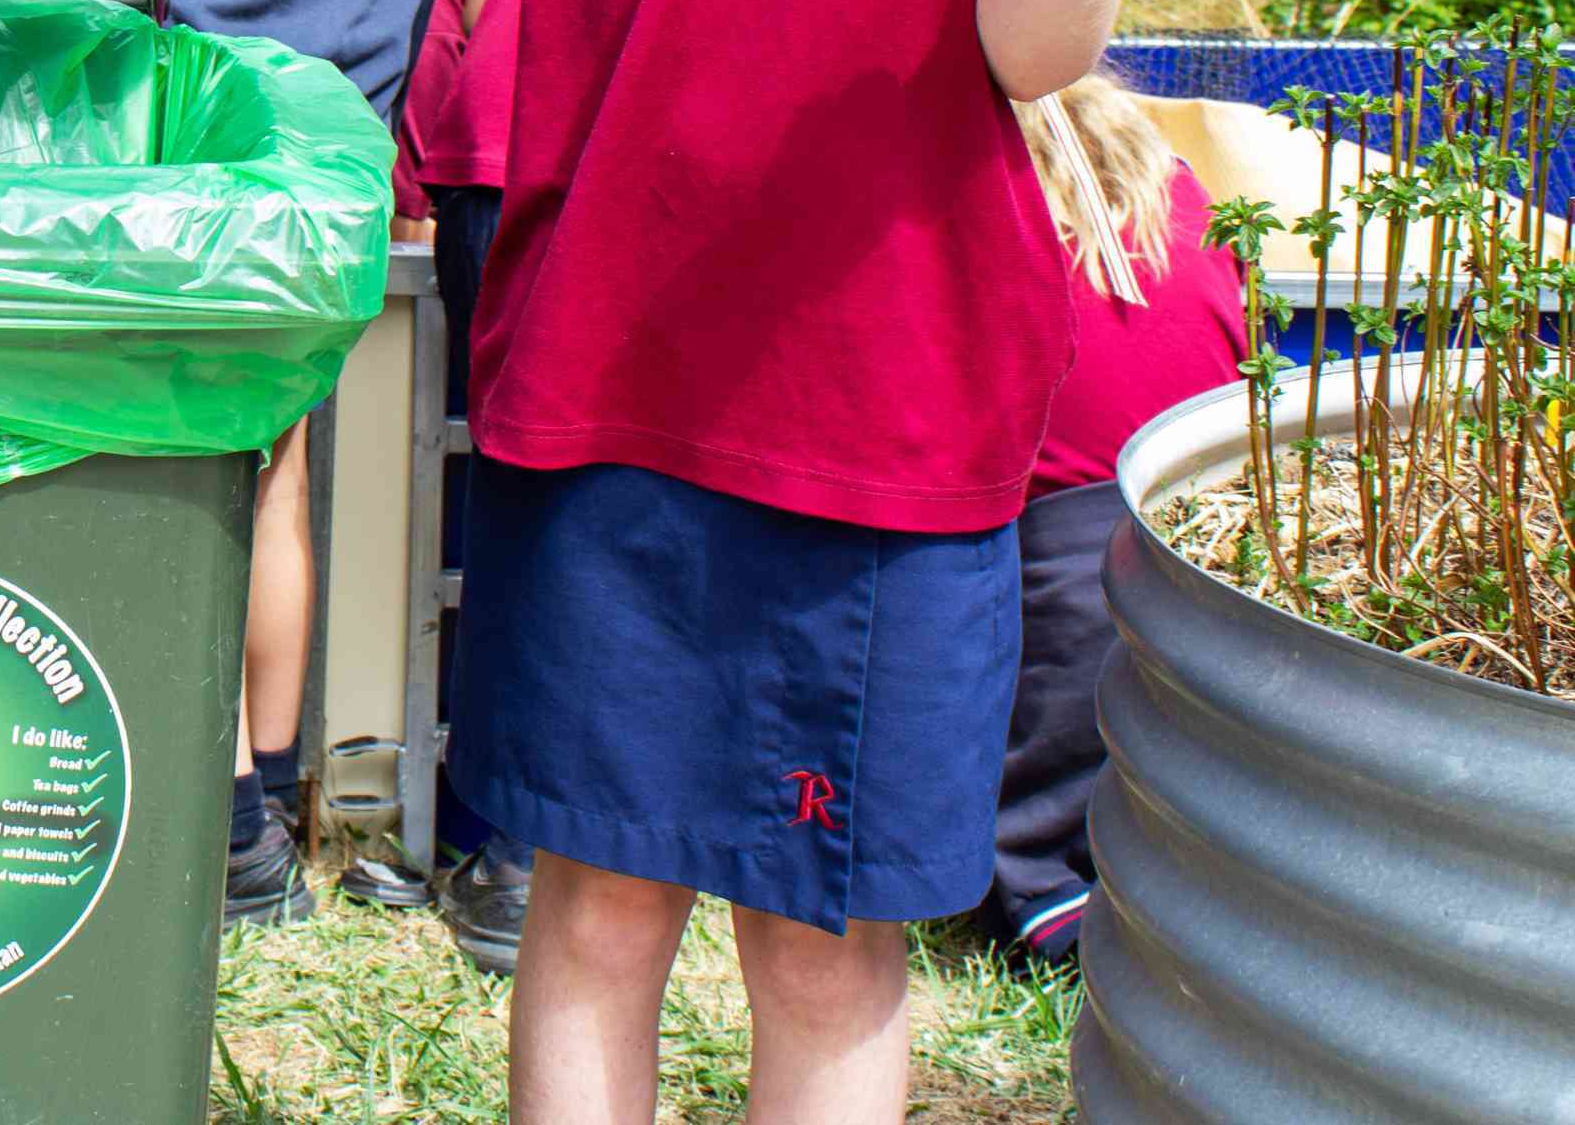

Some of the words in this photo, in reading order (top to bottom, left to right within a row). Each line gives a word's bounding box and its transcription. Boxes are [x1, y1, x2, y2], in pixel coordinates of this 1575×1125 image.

[12, 725, 20, 745] I
[22, 727, 46, 746] do
[49, 728, 89, 750] like:
[49, 756, 83, 770] Bread
[33, 778, 51, 791] Tea
[53, 780, 79, 795] bags
[2, 799, 38, 814] Coffee
[40, 803, 76, 817] grinds
[782, 770, 844, 830] R
[3, 824, 36, 837] paper
[38, 825, 73, 840] towels
[2, 847, 23, 859] and
[25, 848, 69, 863] biscuits
[8, 872, 67, 886] vegetables
